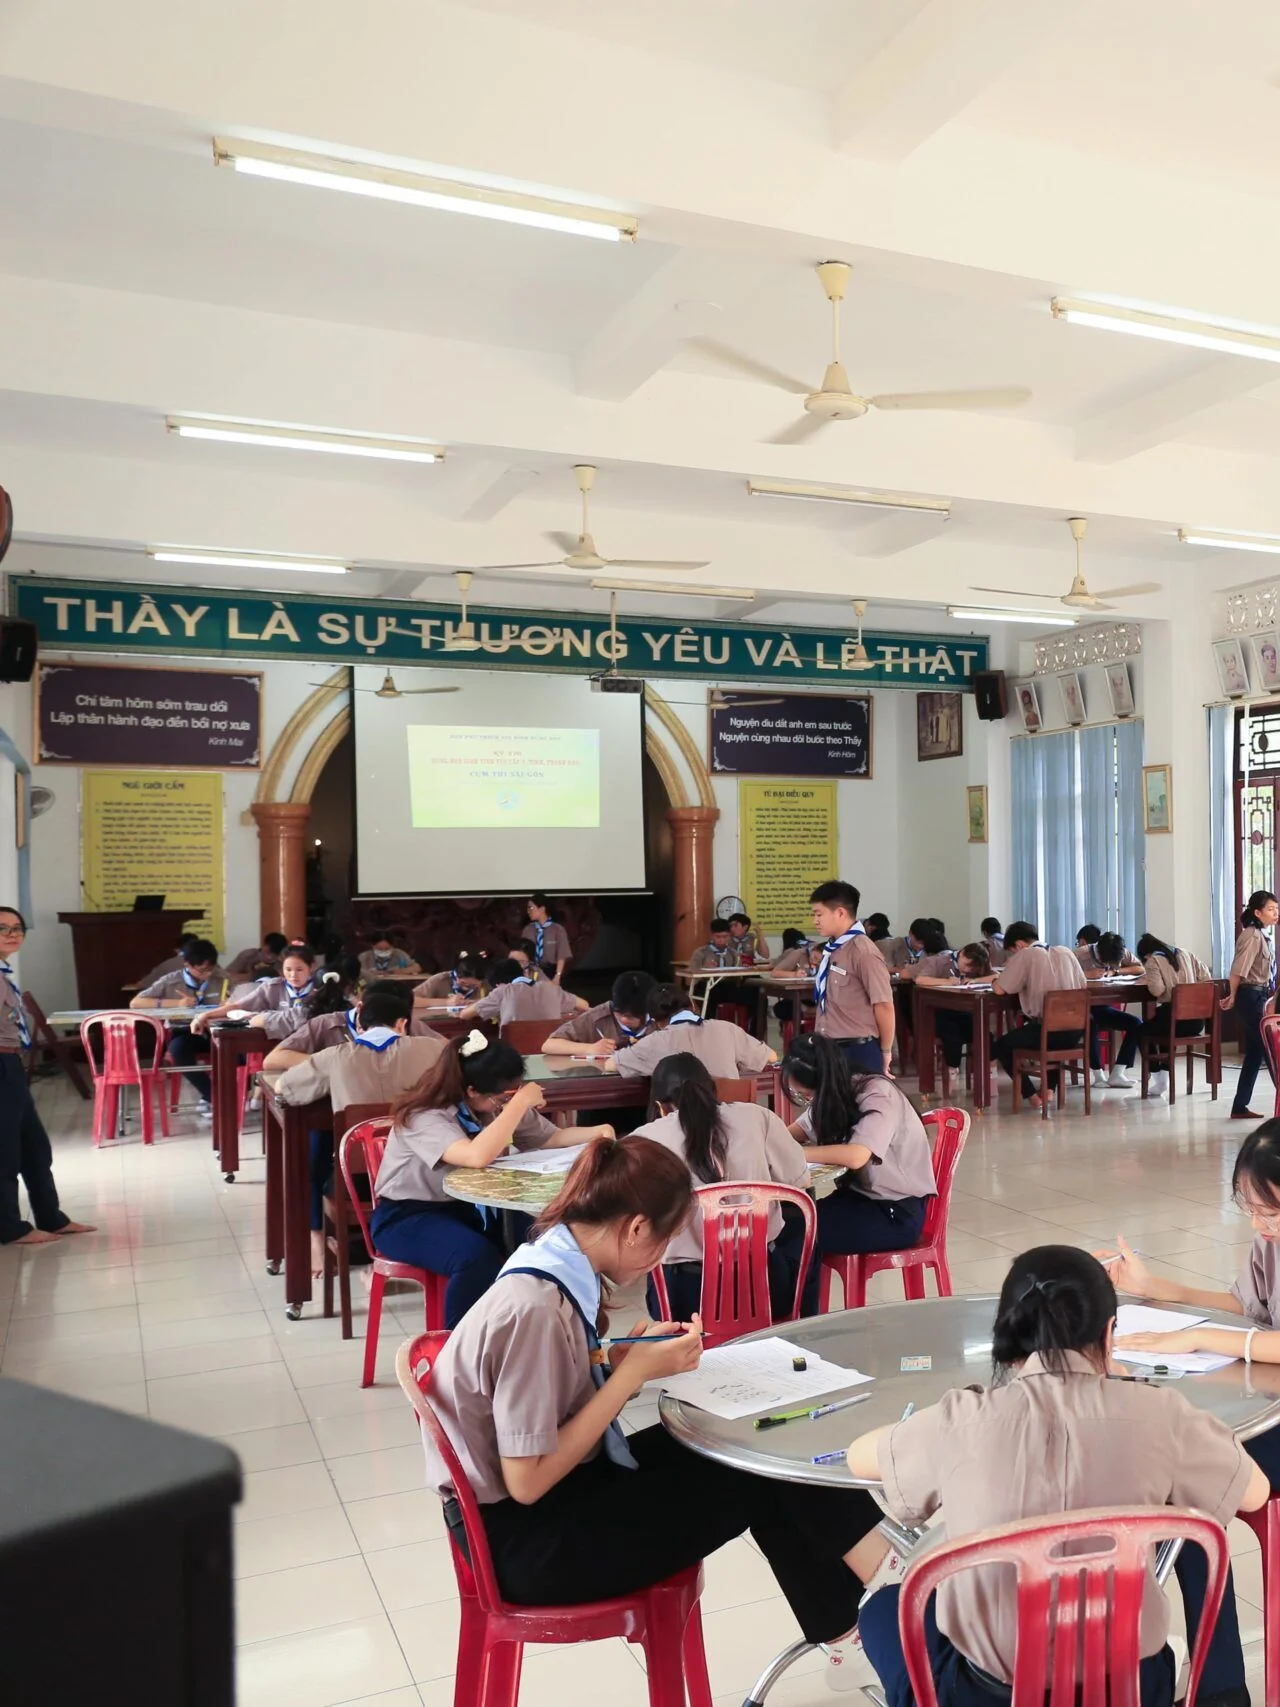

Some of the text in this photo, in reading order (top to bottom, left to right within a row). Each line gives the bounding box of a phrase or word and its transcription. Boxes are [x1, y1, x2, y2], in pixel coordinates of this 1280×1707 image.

[43, 594, 978, 681] THẦY LÀ SỰ THƯƠNG YÊU VÀ LẼ THẬT
[75, 694, 97, 707] Chí
[99, 696, 123, 708] tâm
[126, 697, 153, 709] hôm
[156, 698, 182, 711] sớm
[185, 700, 208, 712] trau
[50, 711, 74, 726] Lập
[77, 712, 104, 725] thân
[107, 714, 139, 726] hành
[141, 715, 164, 729] đạo
[212, 720, 228, 733] nợ
[229, 721, 251, 731] xưa
[730, 717, 759, 729] Nguyện
[788, 720, 803, 729] anh
[804, 721, 817, 729] em
[818, 722, 832, 730] sau
[833, 721, 852, 731] trước
[719, 732, 750, 743] Nguyện
[772, 735, 791, 743] nhau
[806, 735, 825, 744] bước
[826, 735, 842, 745] theo
